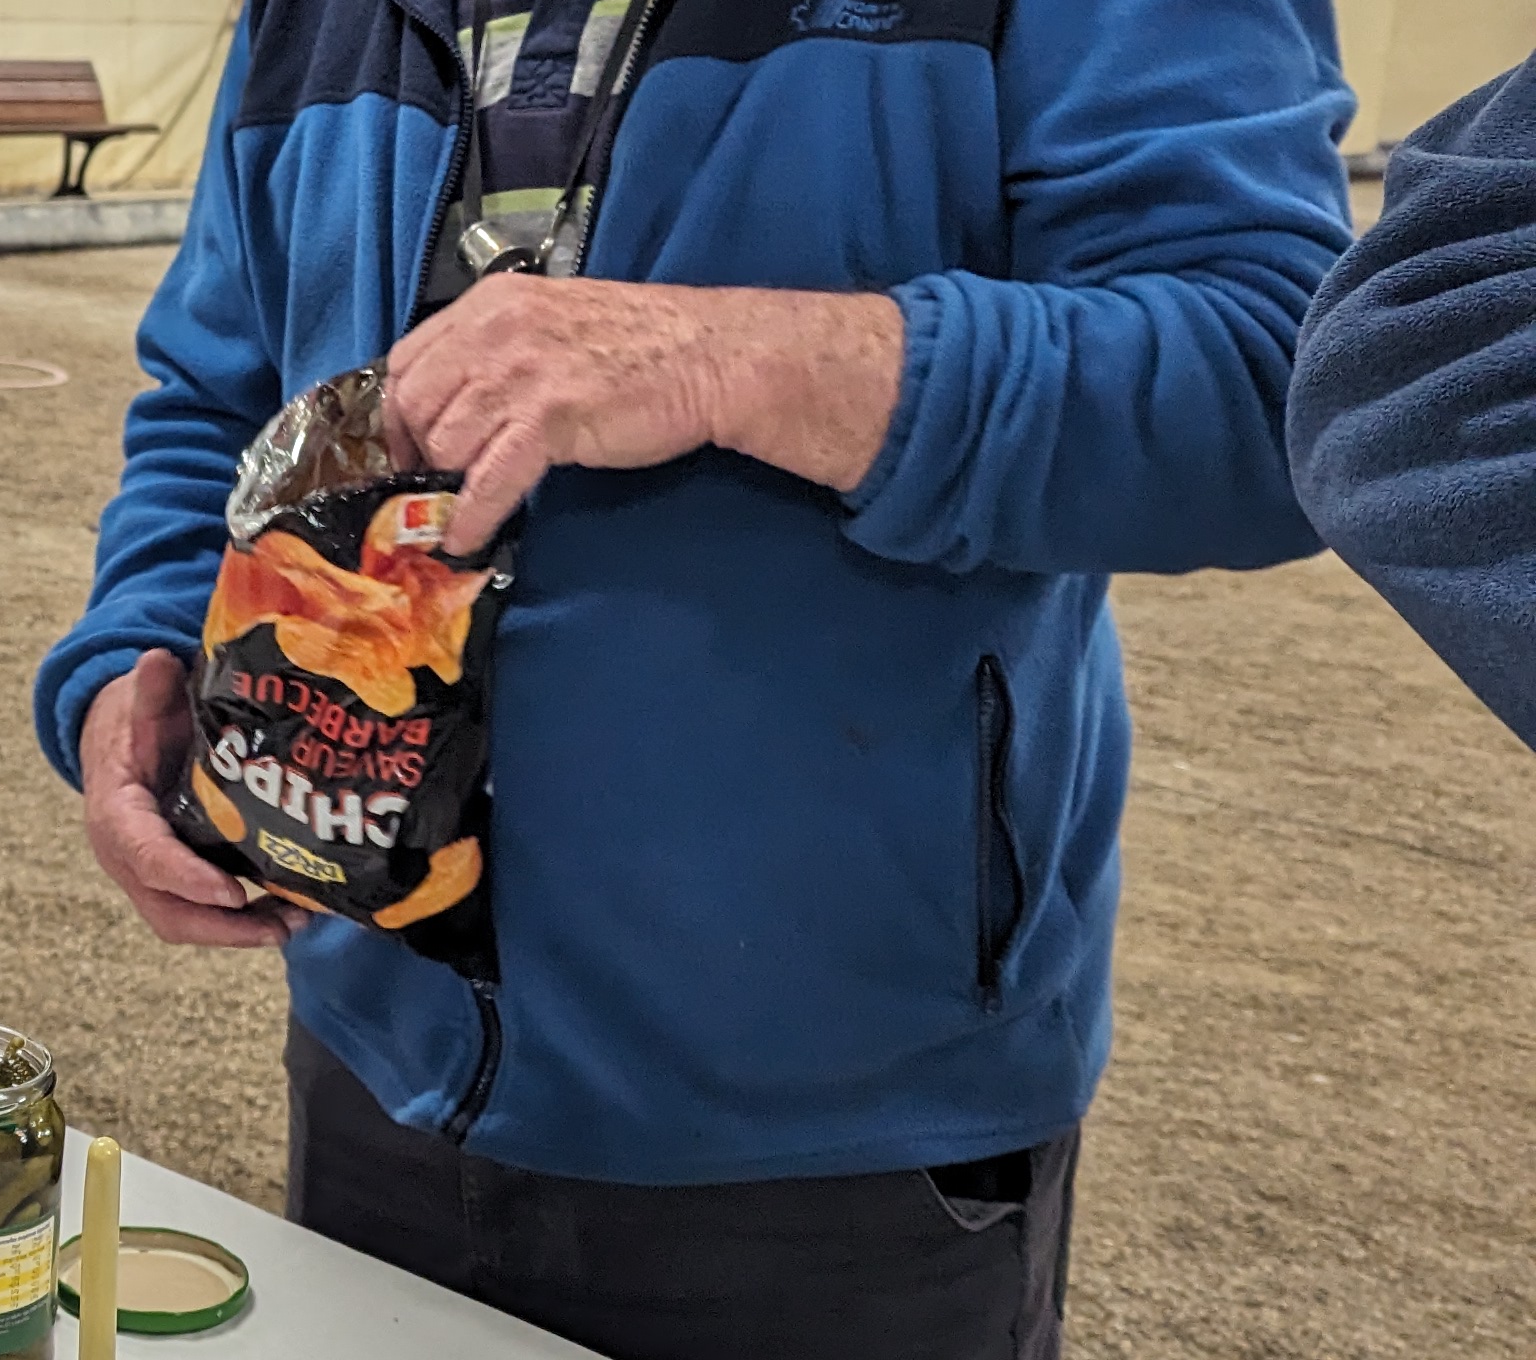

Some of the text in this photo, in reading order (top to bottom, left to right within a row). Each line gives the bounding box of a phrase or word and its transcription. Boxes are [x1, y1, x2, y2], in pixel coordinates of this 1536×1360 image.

[231, 671, 433, 749] BARBECUE
[210, 726, 410, 849] CHIPS
[291, 735, 427, 787] SAVEUR
